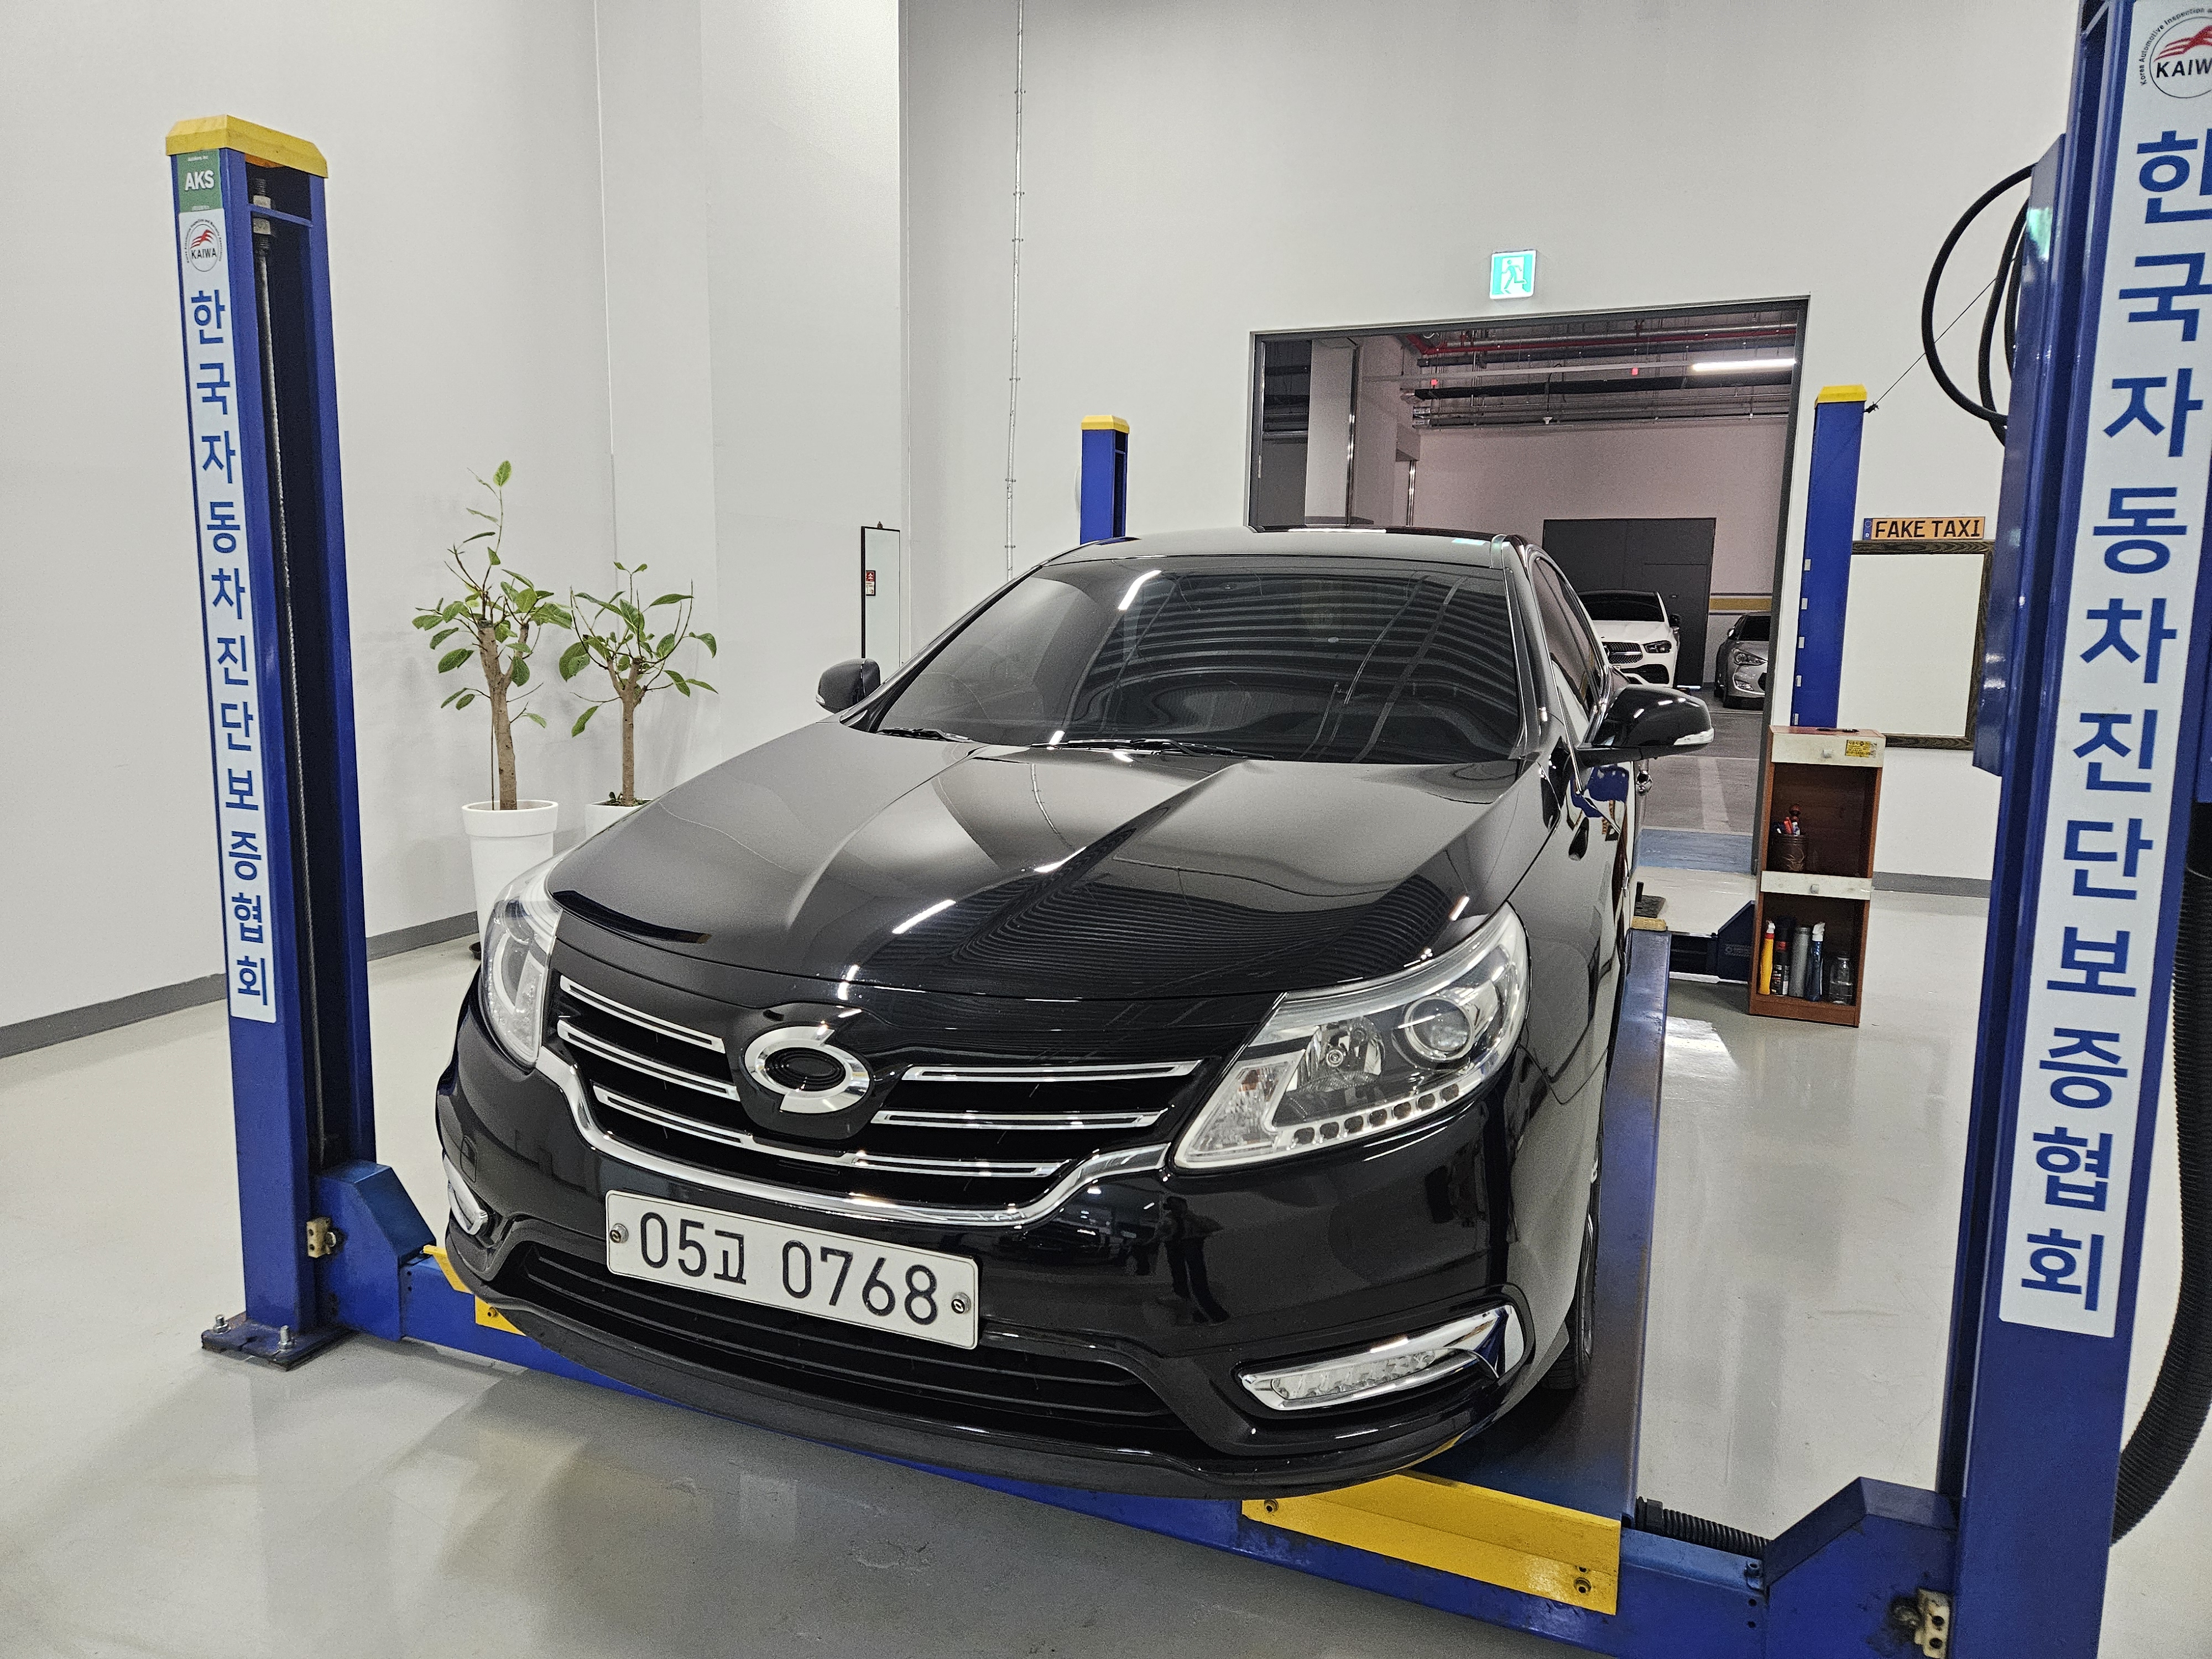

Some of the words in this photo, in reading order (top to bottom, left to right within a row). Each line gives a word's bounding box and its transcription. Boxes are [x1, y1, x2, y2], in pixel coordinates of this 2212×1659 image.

[185, 170, 215, 191] AKS
[191, 248, 217, 260] KAIWA
[1875, 520, 1926, 538] FAKE
[1932, 520, 1980, 538] TAXI
[782, 1239, 938, 1326] 0768
